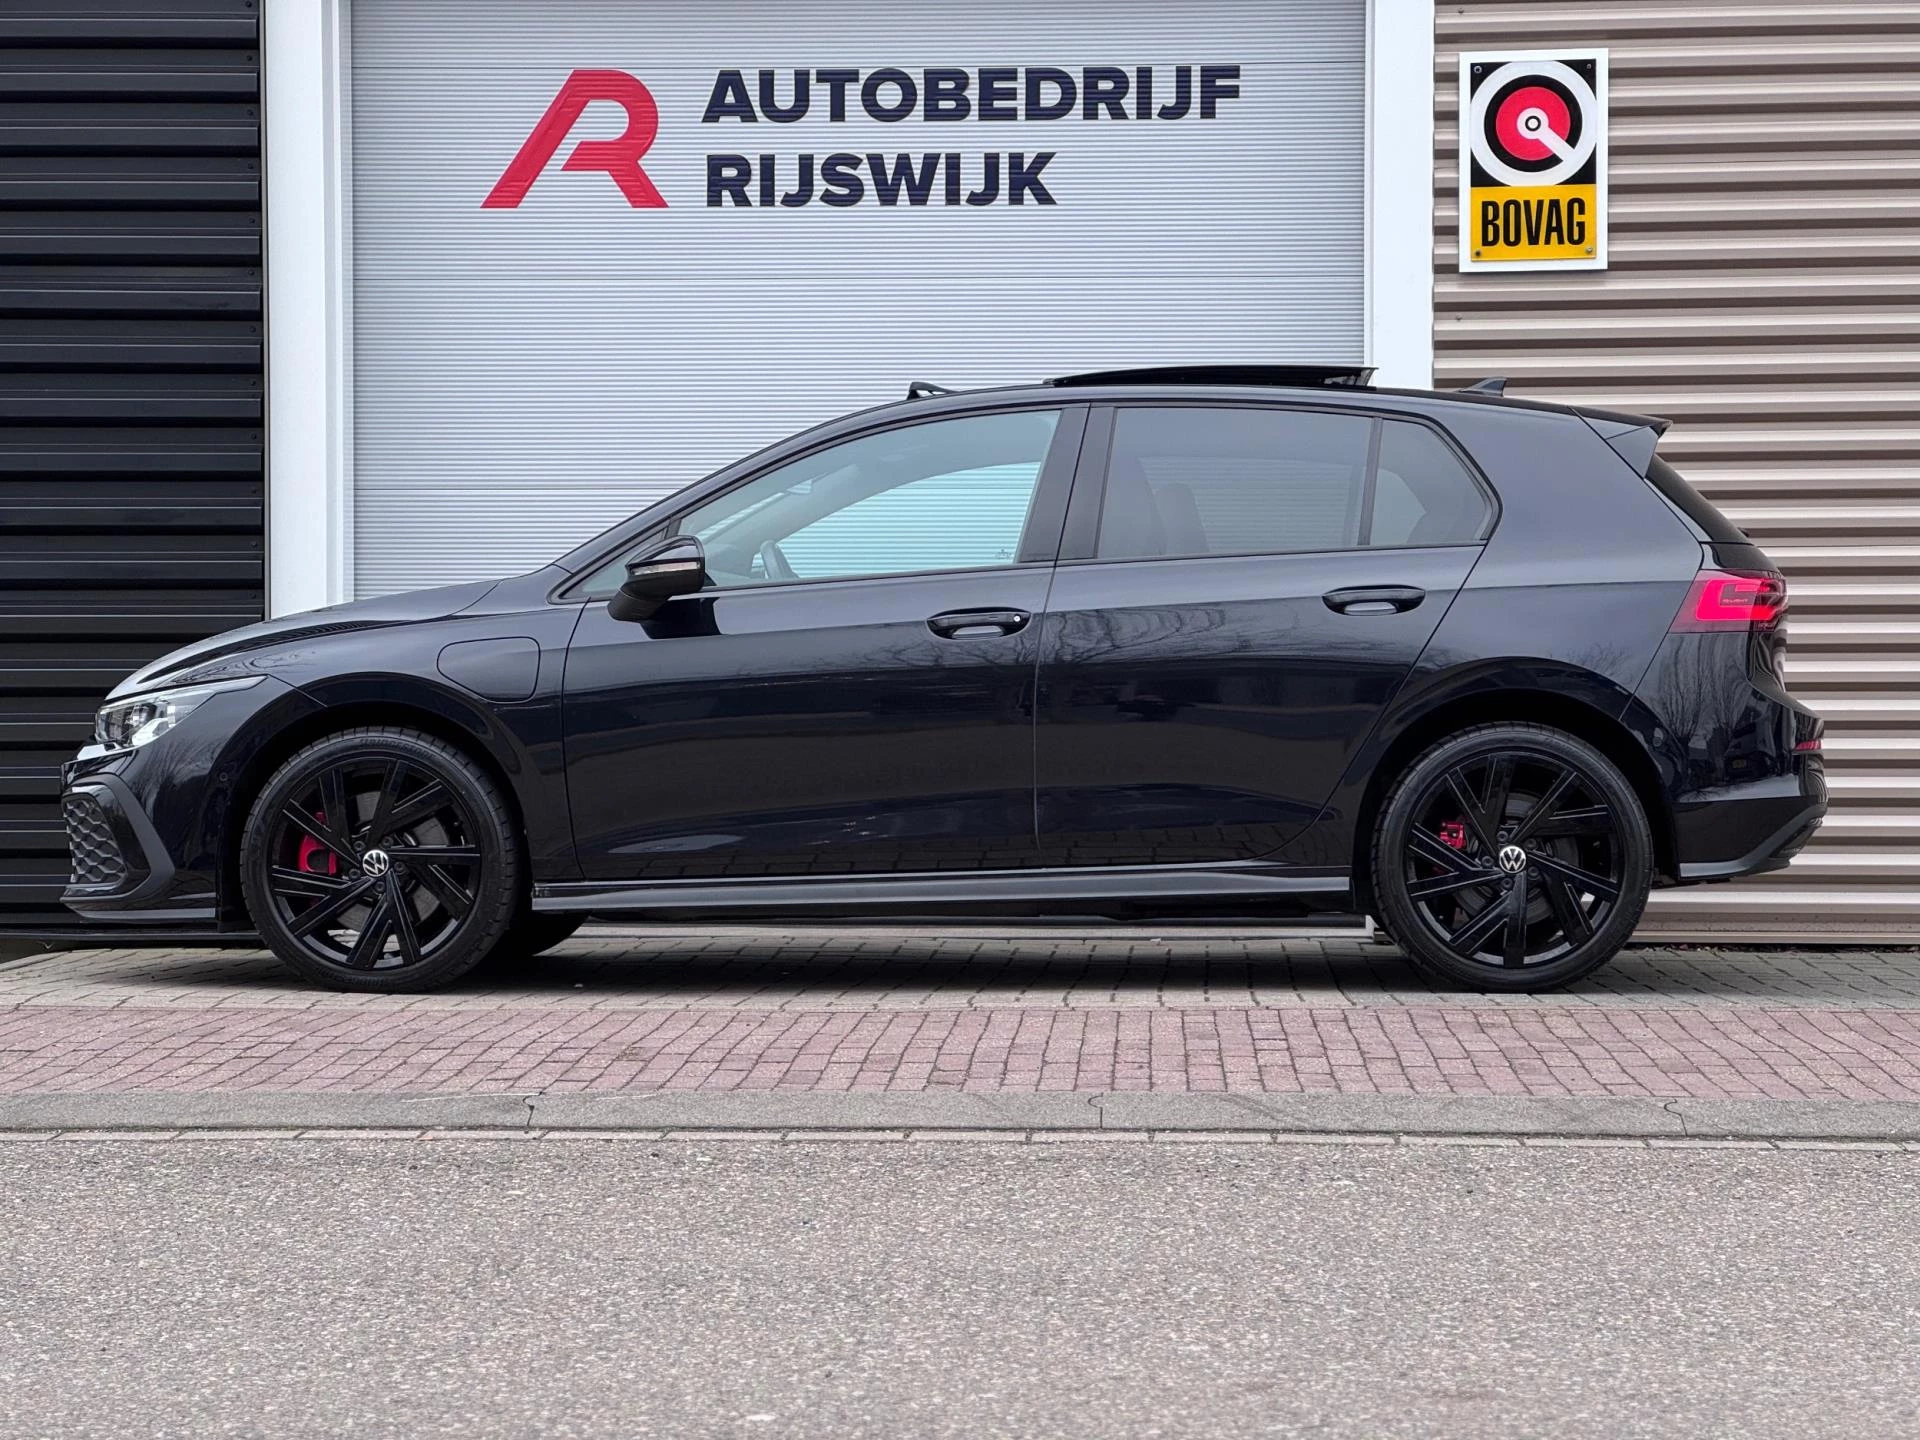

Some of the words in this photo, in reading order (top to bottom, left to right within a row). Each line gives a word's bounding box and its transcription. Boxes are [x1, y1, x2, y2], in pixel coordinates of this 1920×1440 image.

[701, 65, 1241, 124] AUTOBEDRIJF
[706, 151, 1057, 208] RIJSWIJK
[1481, 197, 1586, 247] BOVAG
